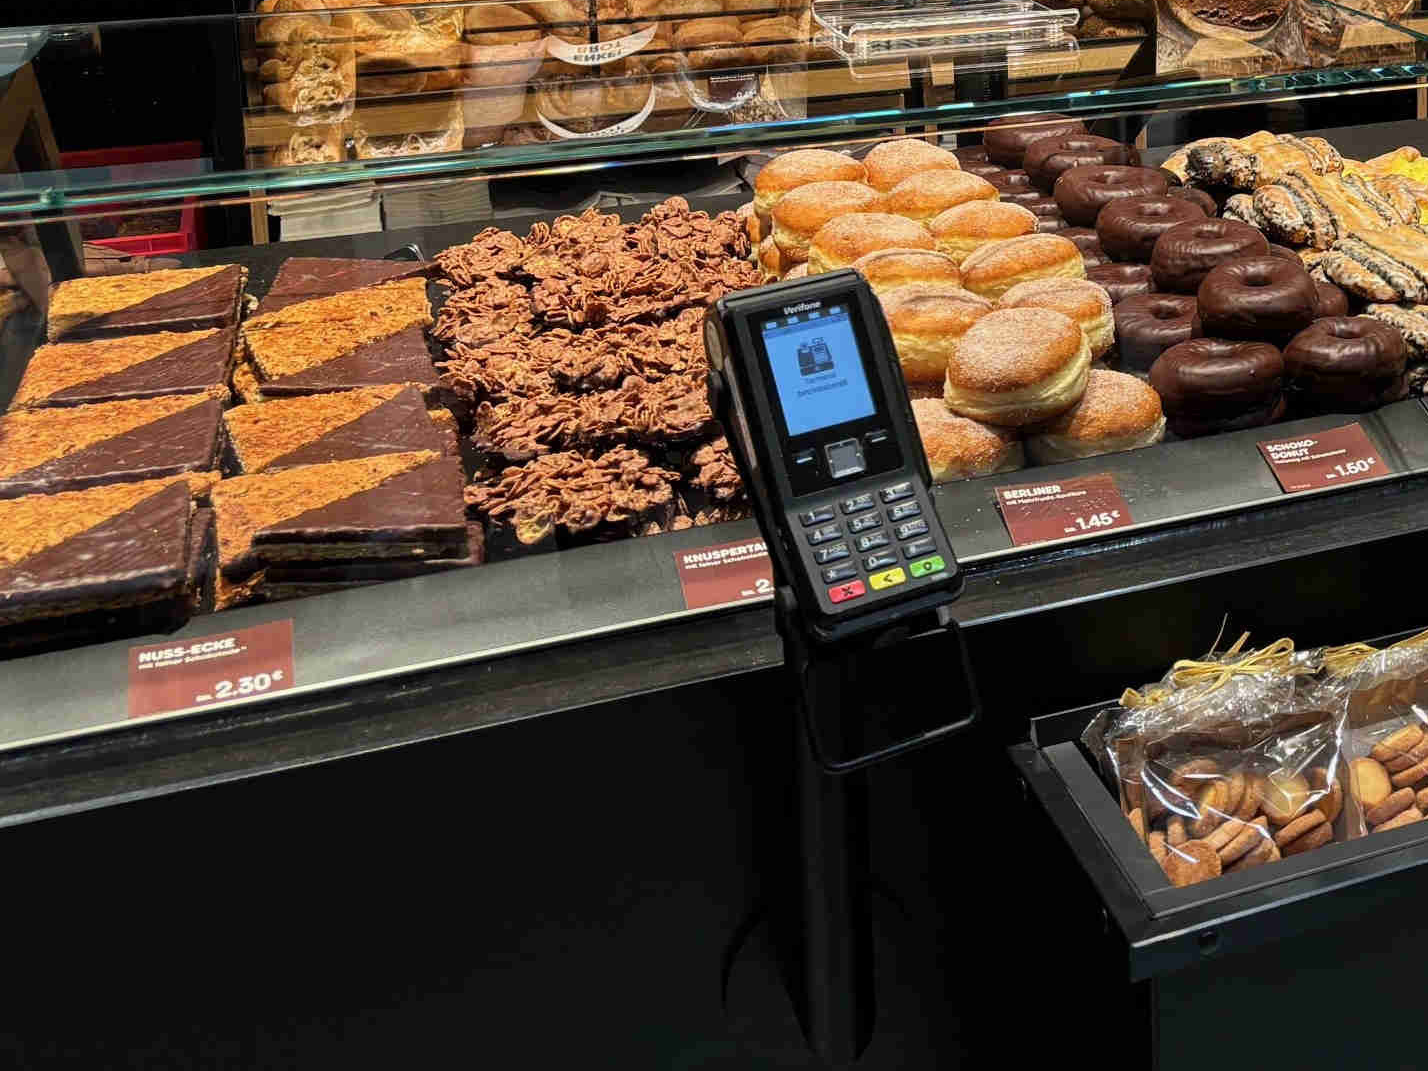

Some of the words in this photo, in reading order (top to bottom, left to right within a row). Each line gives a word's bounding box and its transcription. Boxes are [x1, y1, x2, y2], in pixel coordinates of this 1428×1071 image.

[784, 301, 821, 315] Verifone
[1266, 439, 1318, 453] SCHOKO-
[1003, 485, 1061, 500] BERLINER
[1076, 509, 1121, 530] 1.45€
[138, 637, 236, 663] NUSS-ECKE
[215, 669, 284, 699] 2.30€
